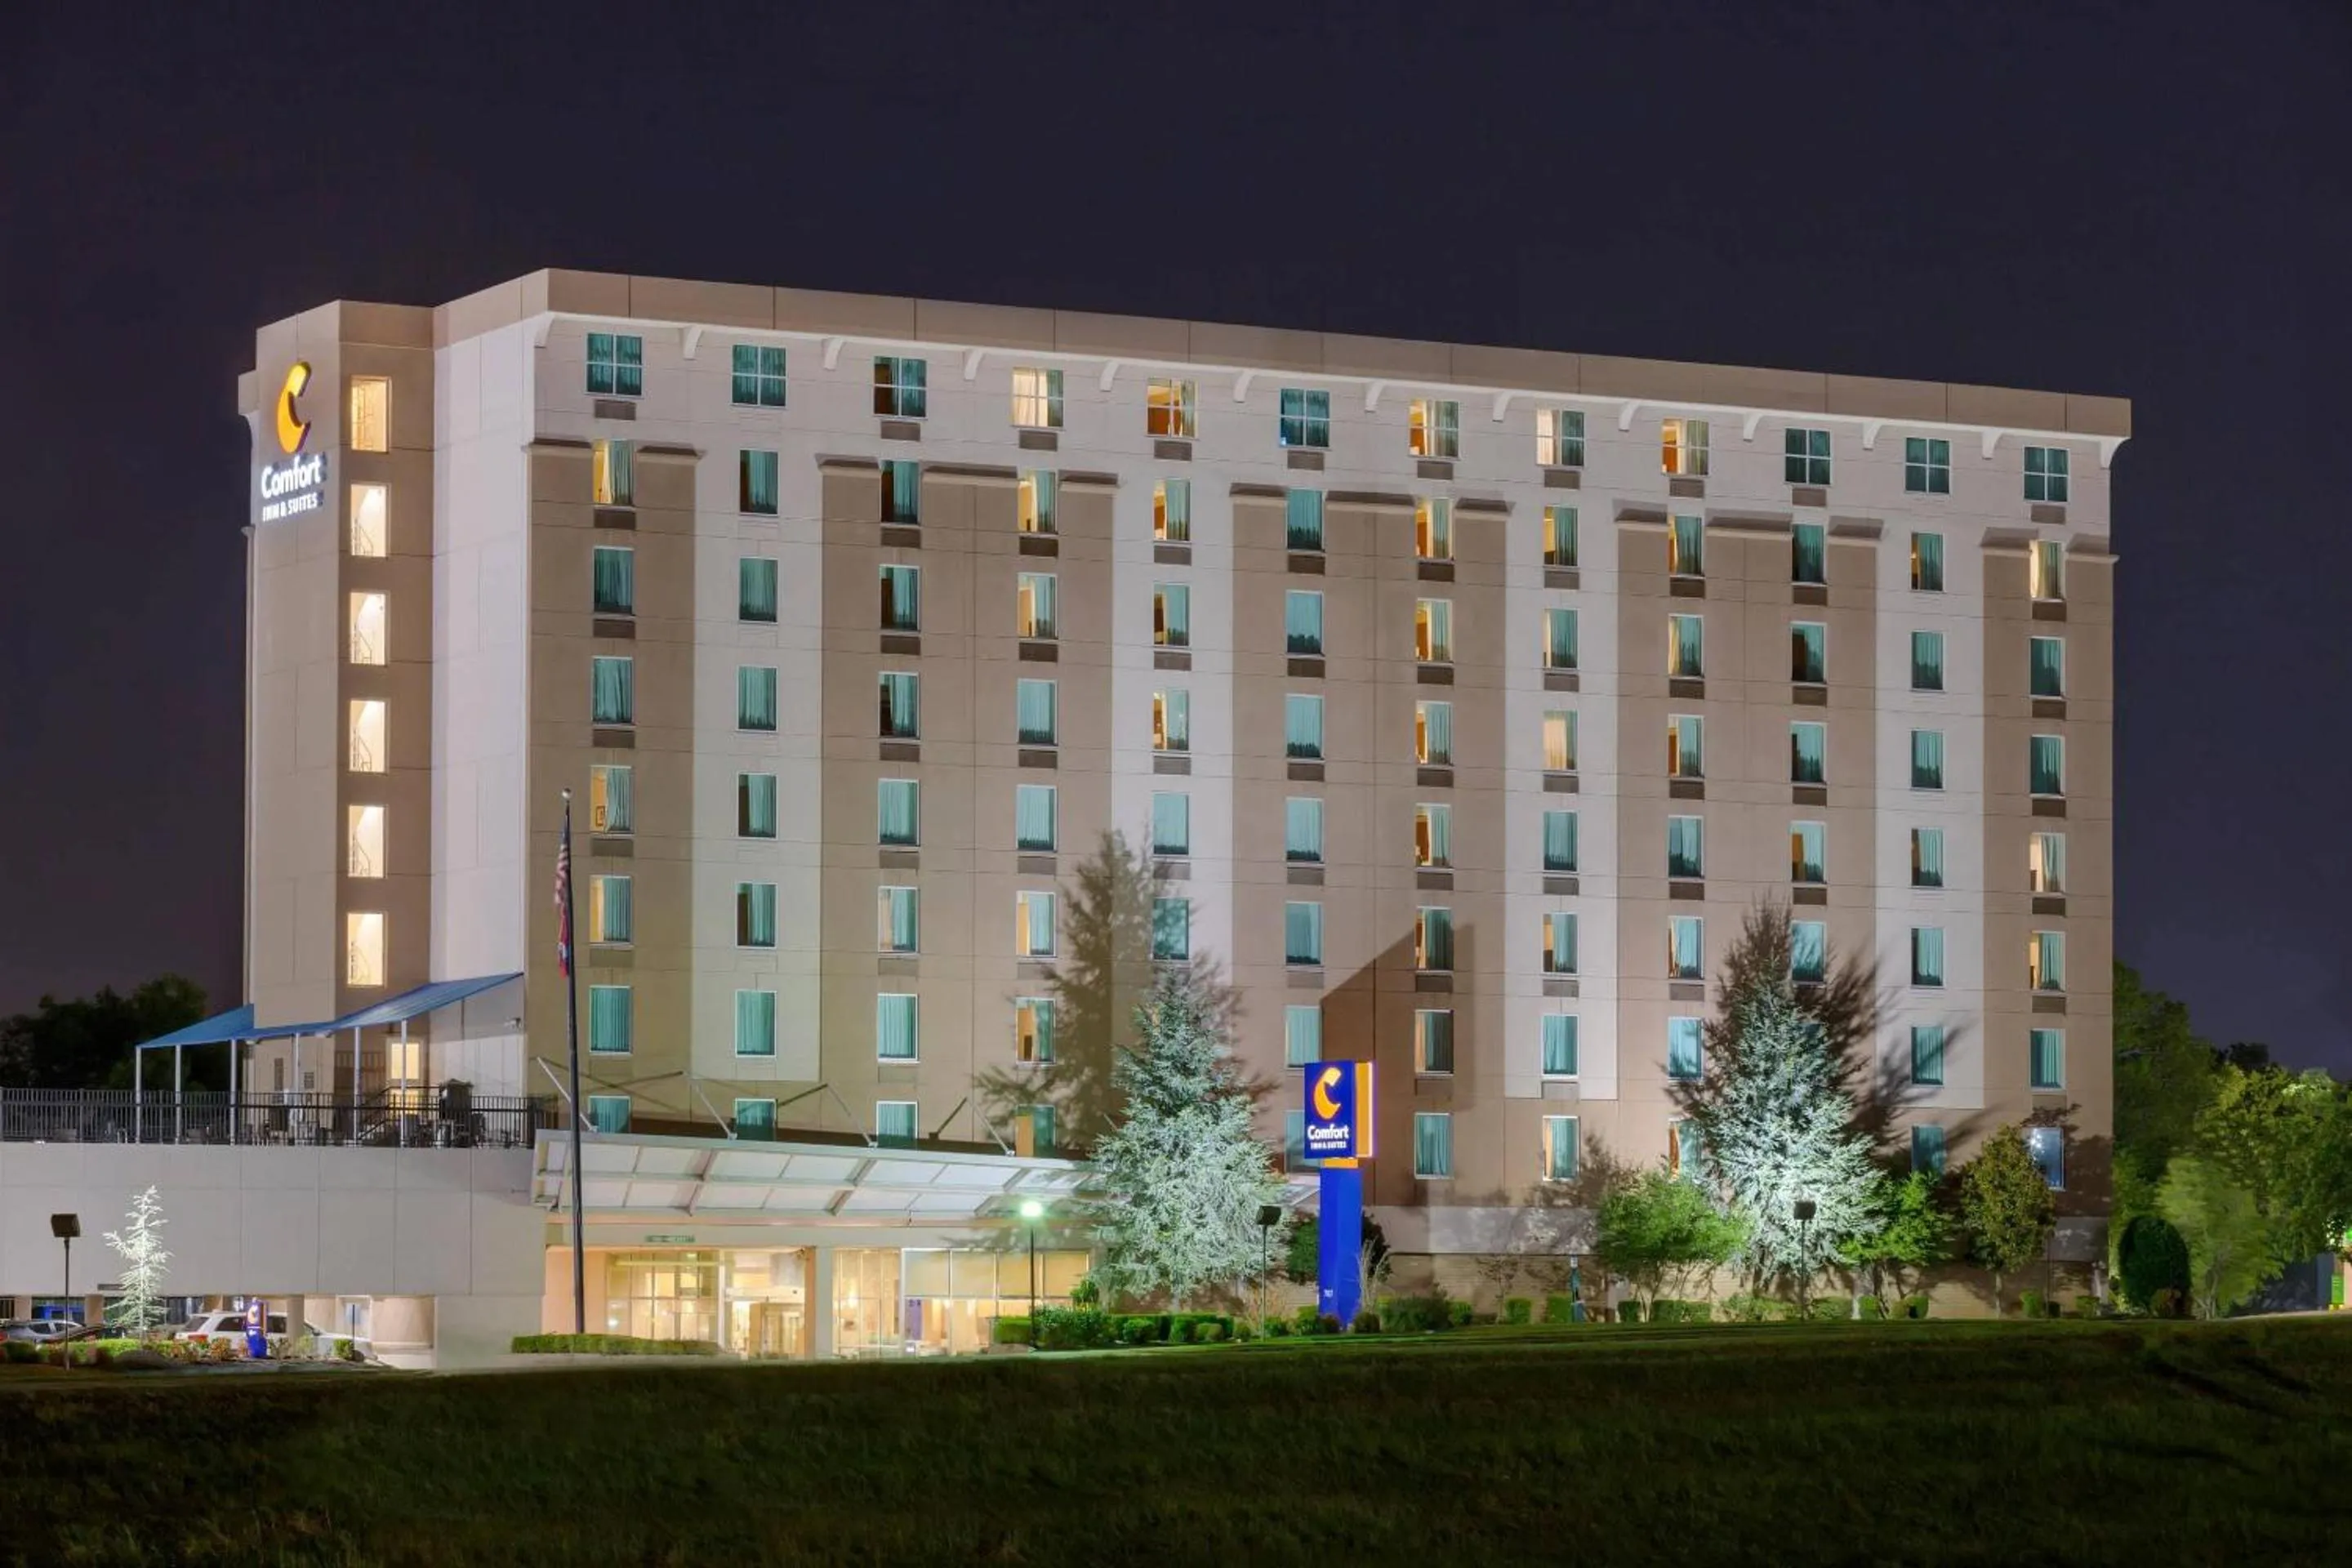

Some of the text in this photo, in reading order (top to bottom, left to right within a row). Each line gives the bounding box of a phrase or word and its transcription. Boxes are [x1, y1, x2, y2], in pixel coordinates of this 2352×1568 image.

[261, 454, 321, 499] Comfort
[263, 504, 279, 522] INN
[287, 492, 318, 514] SUITES
[1307, 1124, 1349, 1140] Comfort
